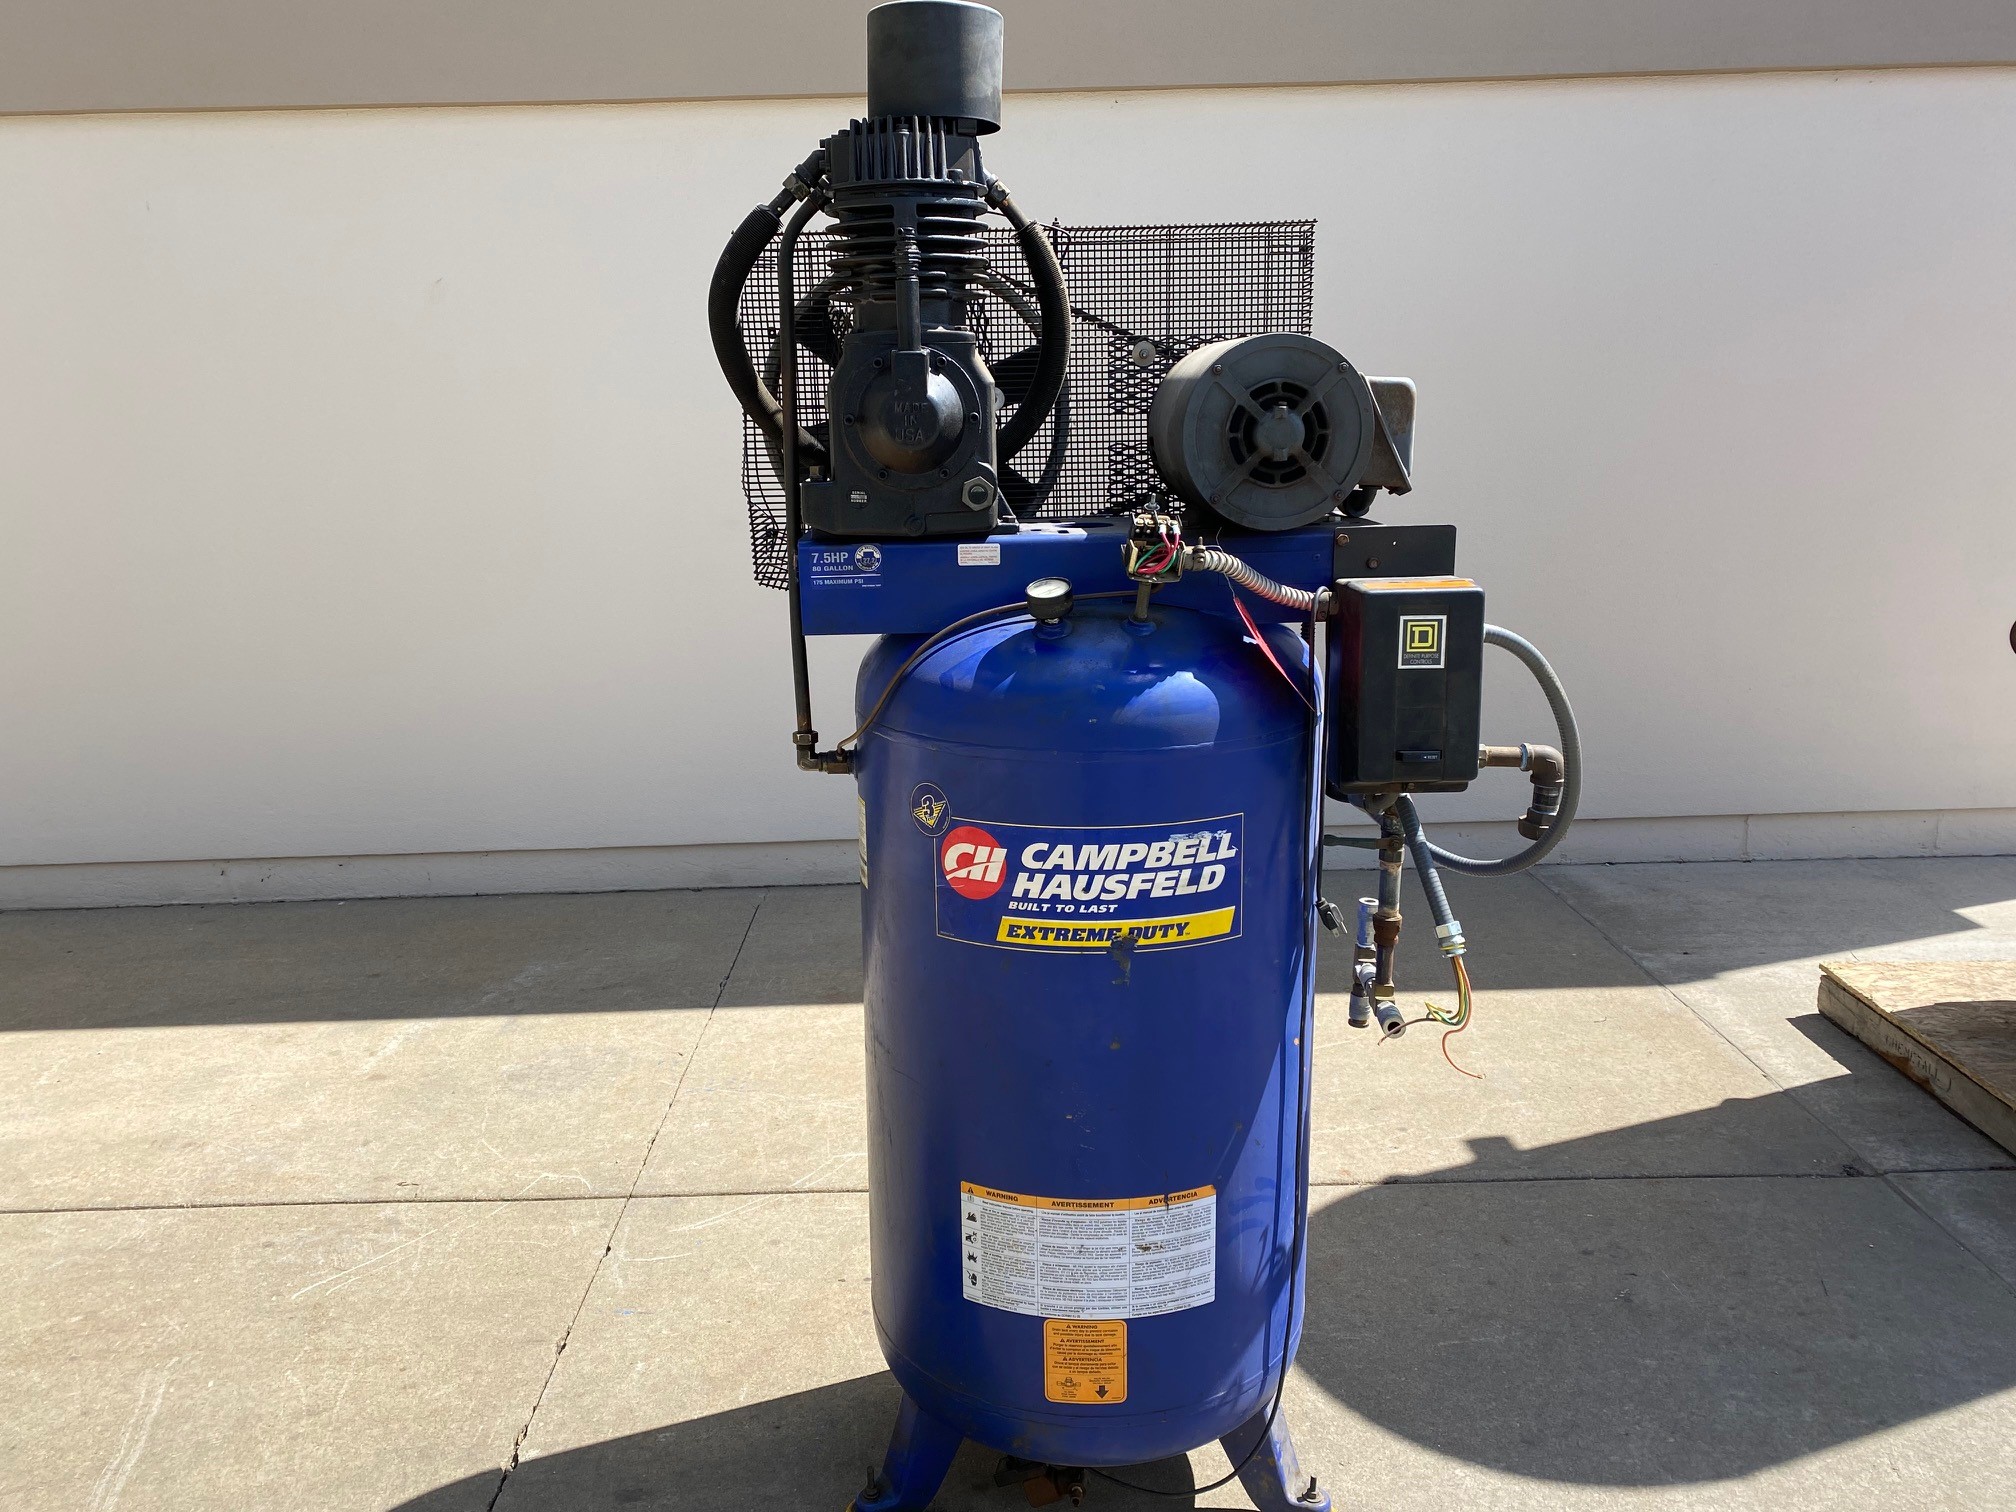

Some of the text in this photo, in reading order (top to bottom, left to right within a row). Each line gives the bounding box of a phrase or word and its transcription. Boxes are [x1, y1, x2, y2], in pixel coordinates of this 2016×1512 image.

[894, 402, 928, 413] MADE
[895, 429, 924, 442] USA
[811, 552, 849, 564] 7.5HP
[1021, 832, 1237, 870] CAMPBELL
[1011, 864, 1226, 900] HAUSFELD
[1008, 901, 1118, 914] BUILT TO LAST
[1006, 923, 1122, 943] EXTREME
[985, 1190, 1019, 1202] WARNING
[1051, 1200, 1115, 1209] AVERTISSEMENT
